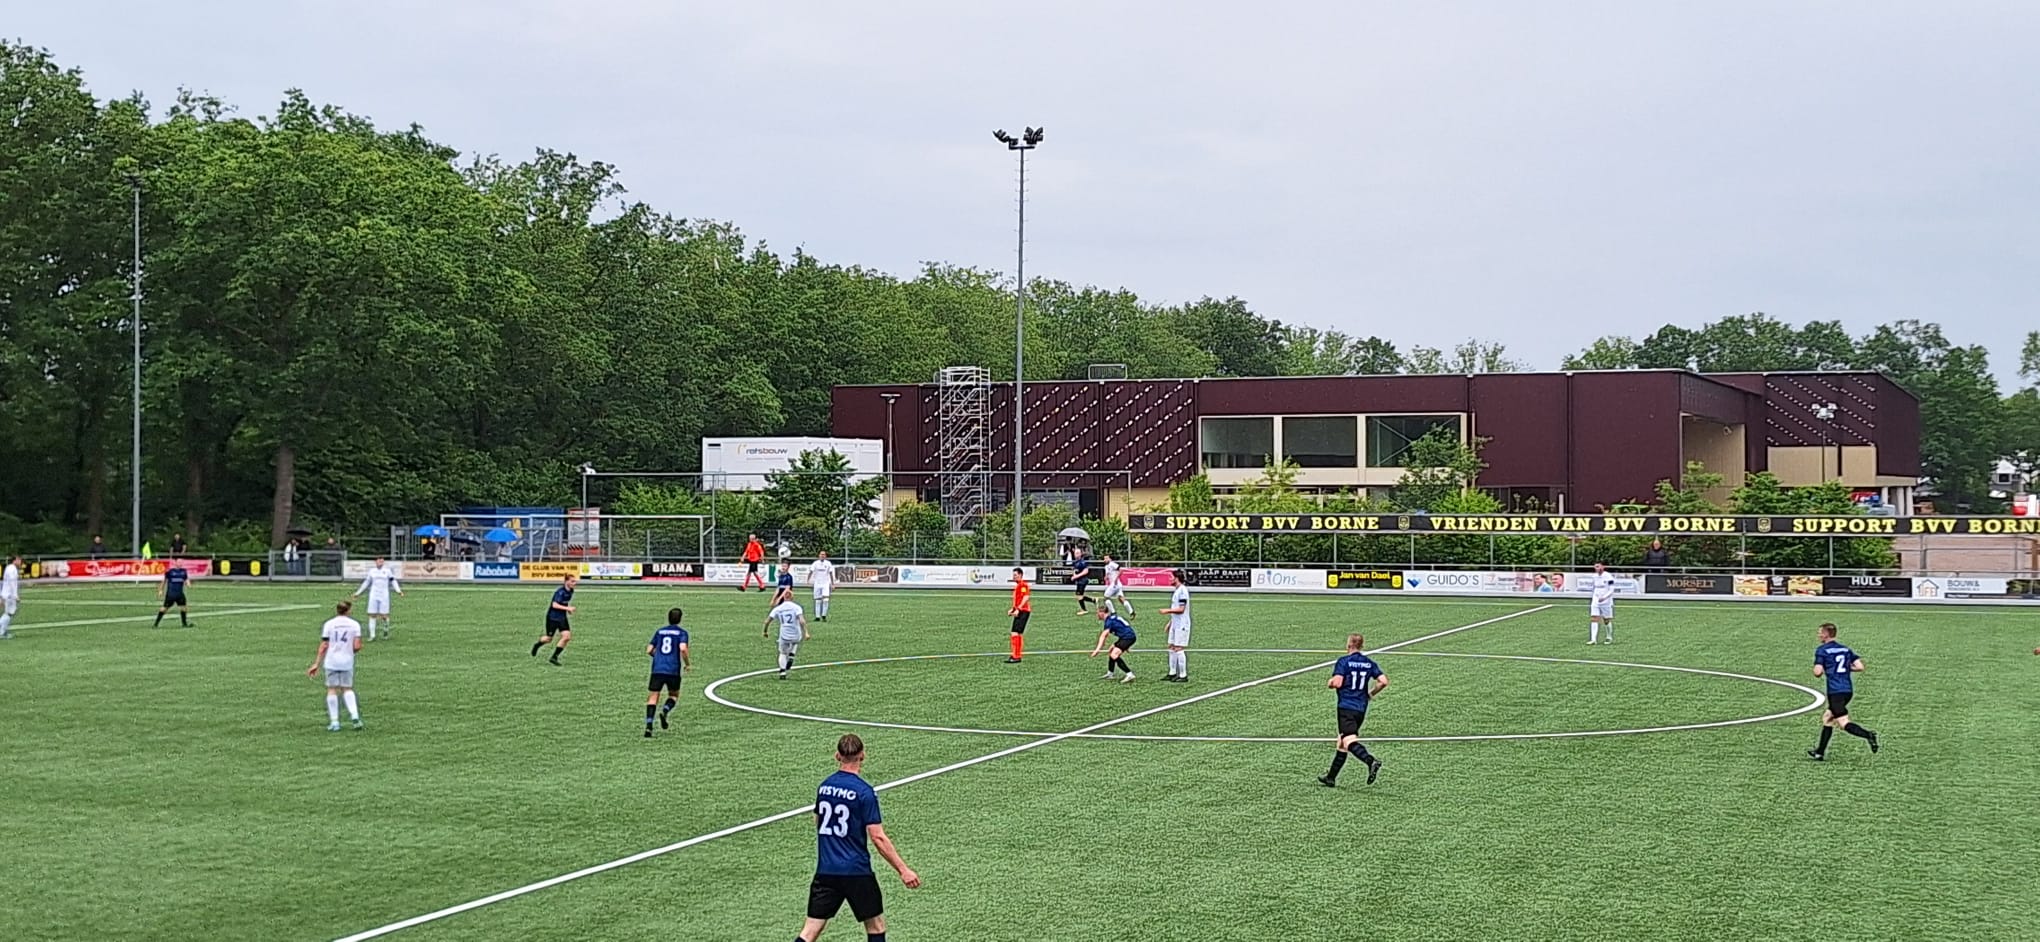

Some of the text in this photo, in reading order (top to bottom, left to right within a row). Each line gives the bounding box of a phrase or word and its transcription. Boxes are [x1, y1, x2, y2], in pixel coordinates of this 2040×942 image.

[1166, 515, 1380, 530] SUPPORT BVV BORNE
[1430, 517, 1736, 532] VRIENDEN VAN BVV BORNE
[1793, 518, 1897, 533] SUPPORT
[1910, 519, 1957, 533] BVV
[475, 564, 519, 577] Rabobank
[652, 563, 693, 573] BRAMA
[1339, 571, 1354, 579] Jan
[1851, 576, 1883, 586] HULS
[1666, 579, 1716, 588] MORSELT
[780, 613, 793, 624] 12
[335, 630, 348, 643] 14
[661, 636, 672, 654] 8
[1835, 654, 1846, 673] 2
[818, 800, 850, 838] 23
